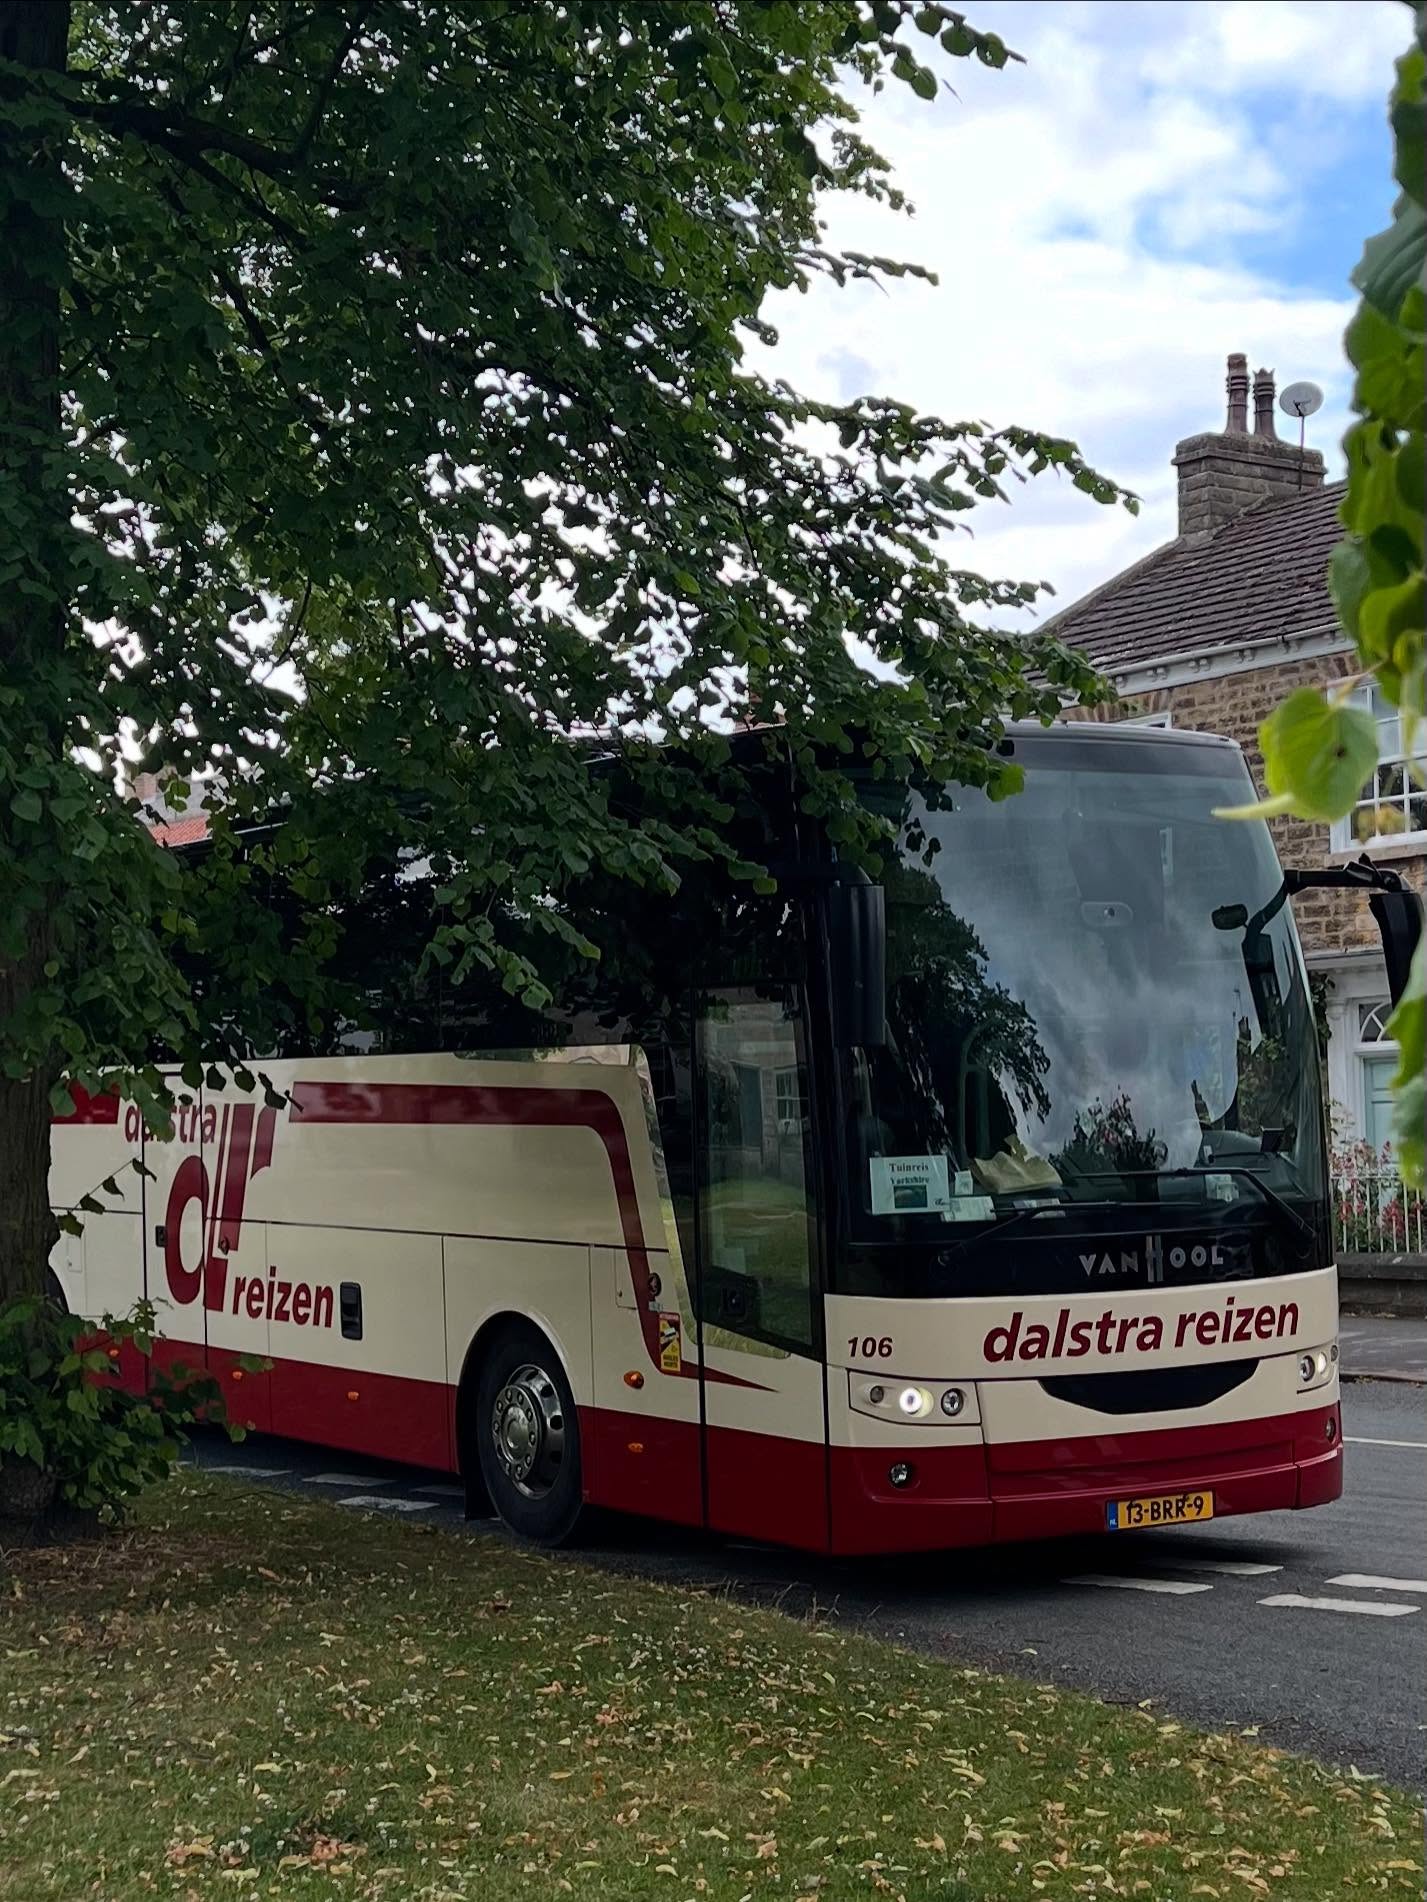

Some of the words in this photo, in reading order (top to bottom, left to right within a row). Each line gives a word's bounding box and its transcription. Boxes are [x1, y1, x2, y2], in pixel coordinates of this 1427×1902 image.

[125, 1104, 217, 1143] dtra
[1079, 1252, 1139, 1277] VAN
[1145, 1235, 1224, 1282] HOOL
[232, 1266, 334, 1329] reizen
[848, 1336, 893, 1358] 106
[982, 1308, 1164, 1363] dalstra
[1174, 1296, 1300, 1348] reizen
